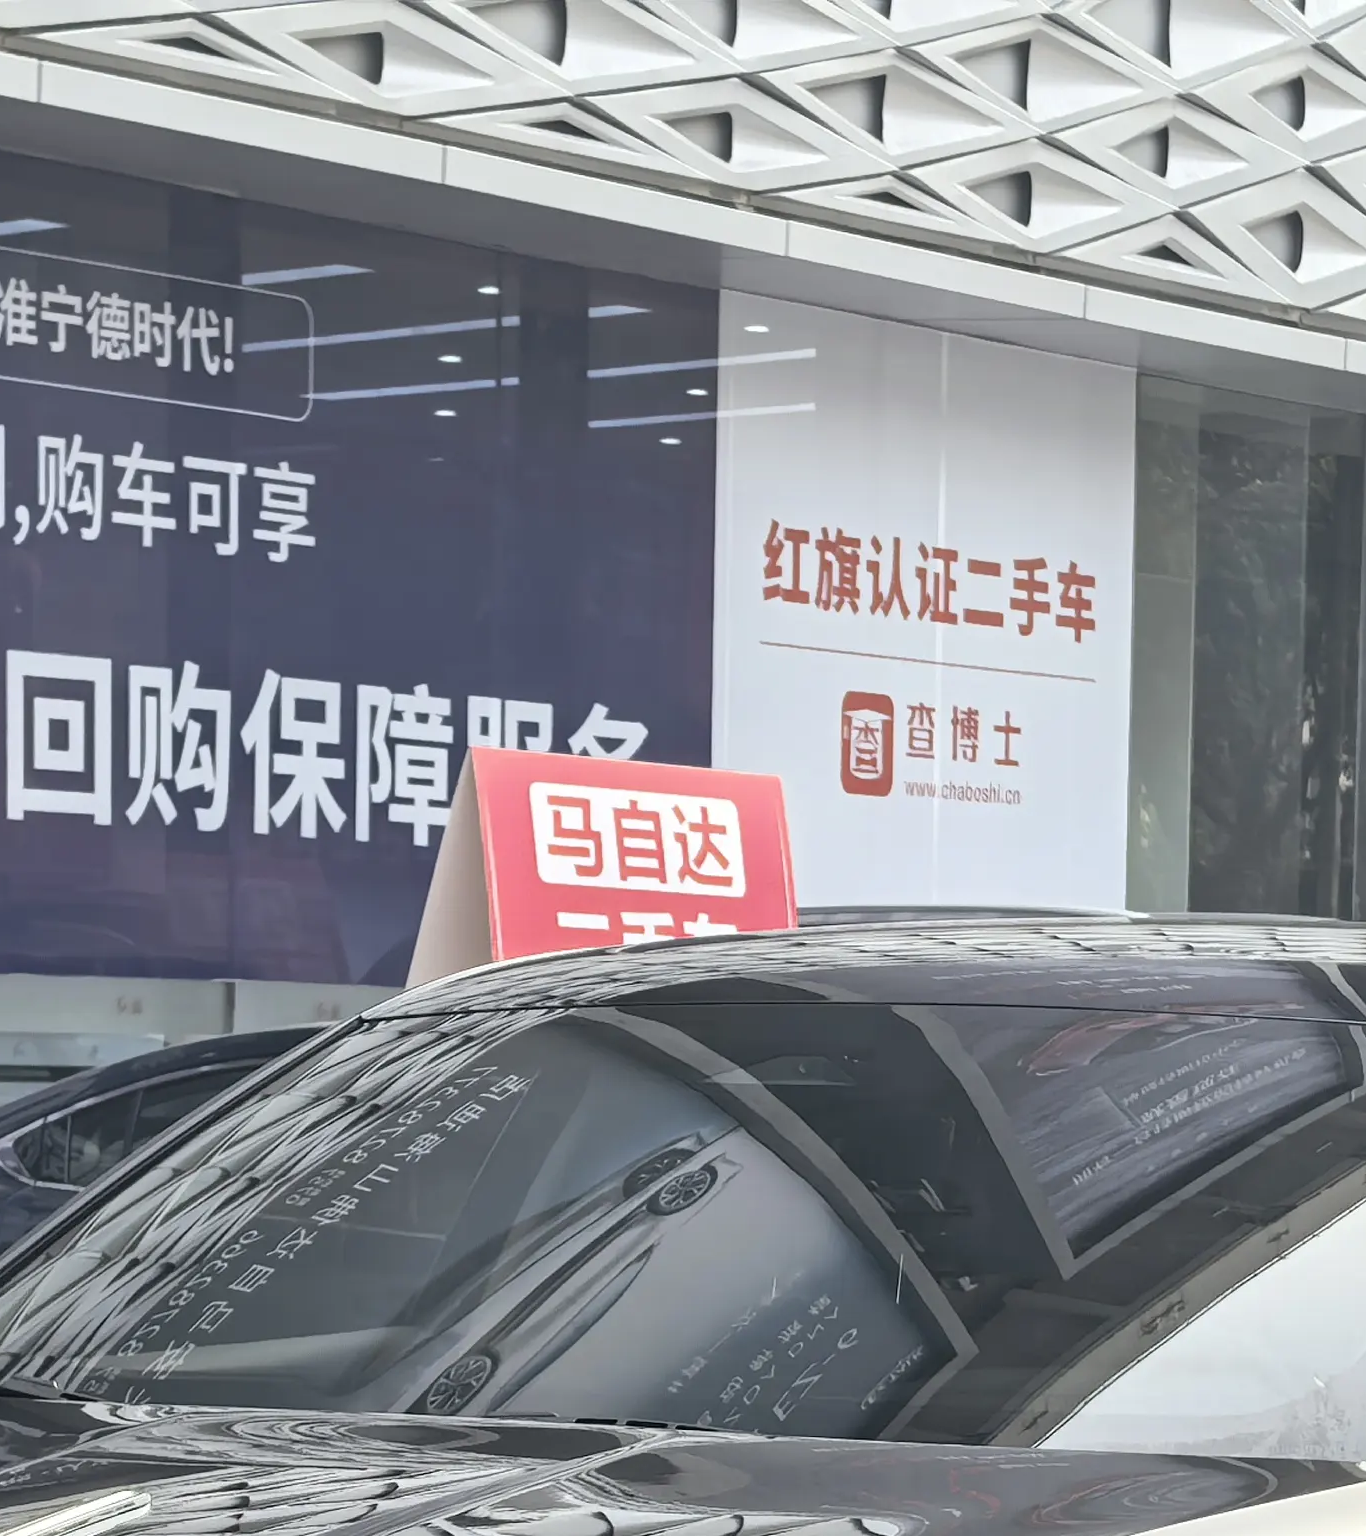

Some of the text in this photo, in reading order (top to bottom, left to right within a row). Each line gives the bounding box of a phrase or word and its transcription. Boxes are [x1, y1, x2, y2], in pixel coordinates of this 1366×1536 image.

[761, 518, 1096, 643] 红旗认证二手车
[905, 702, 1022, 768] 查博士
[547, 794, 734, 888] 马自达
